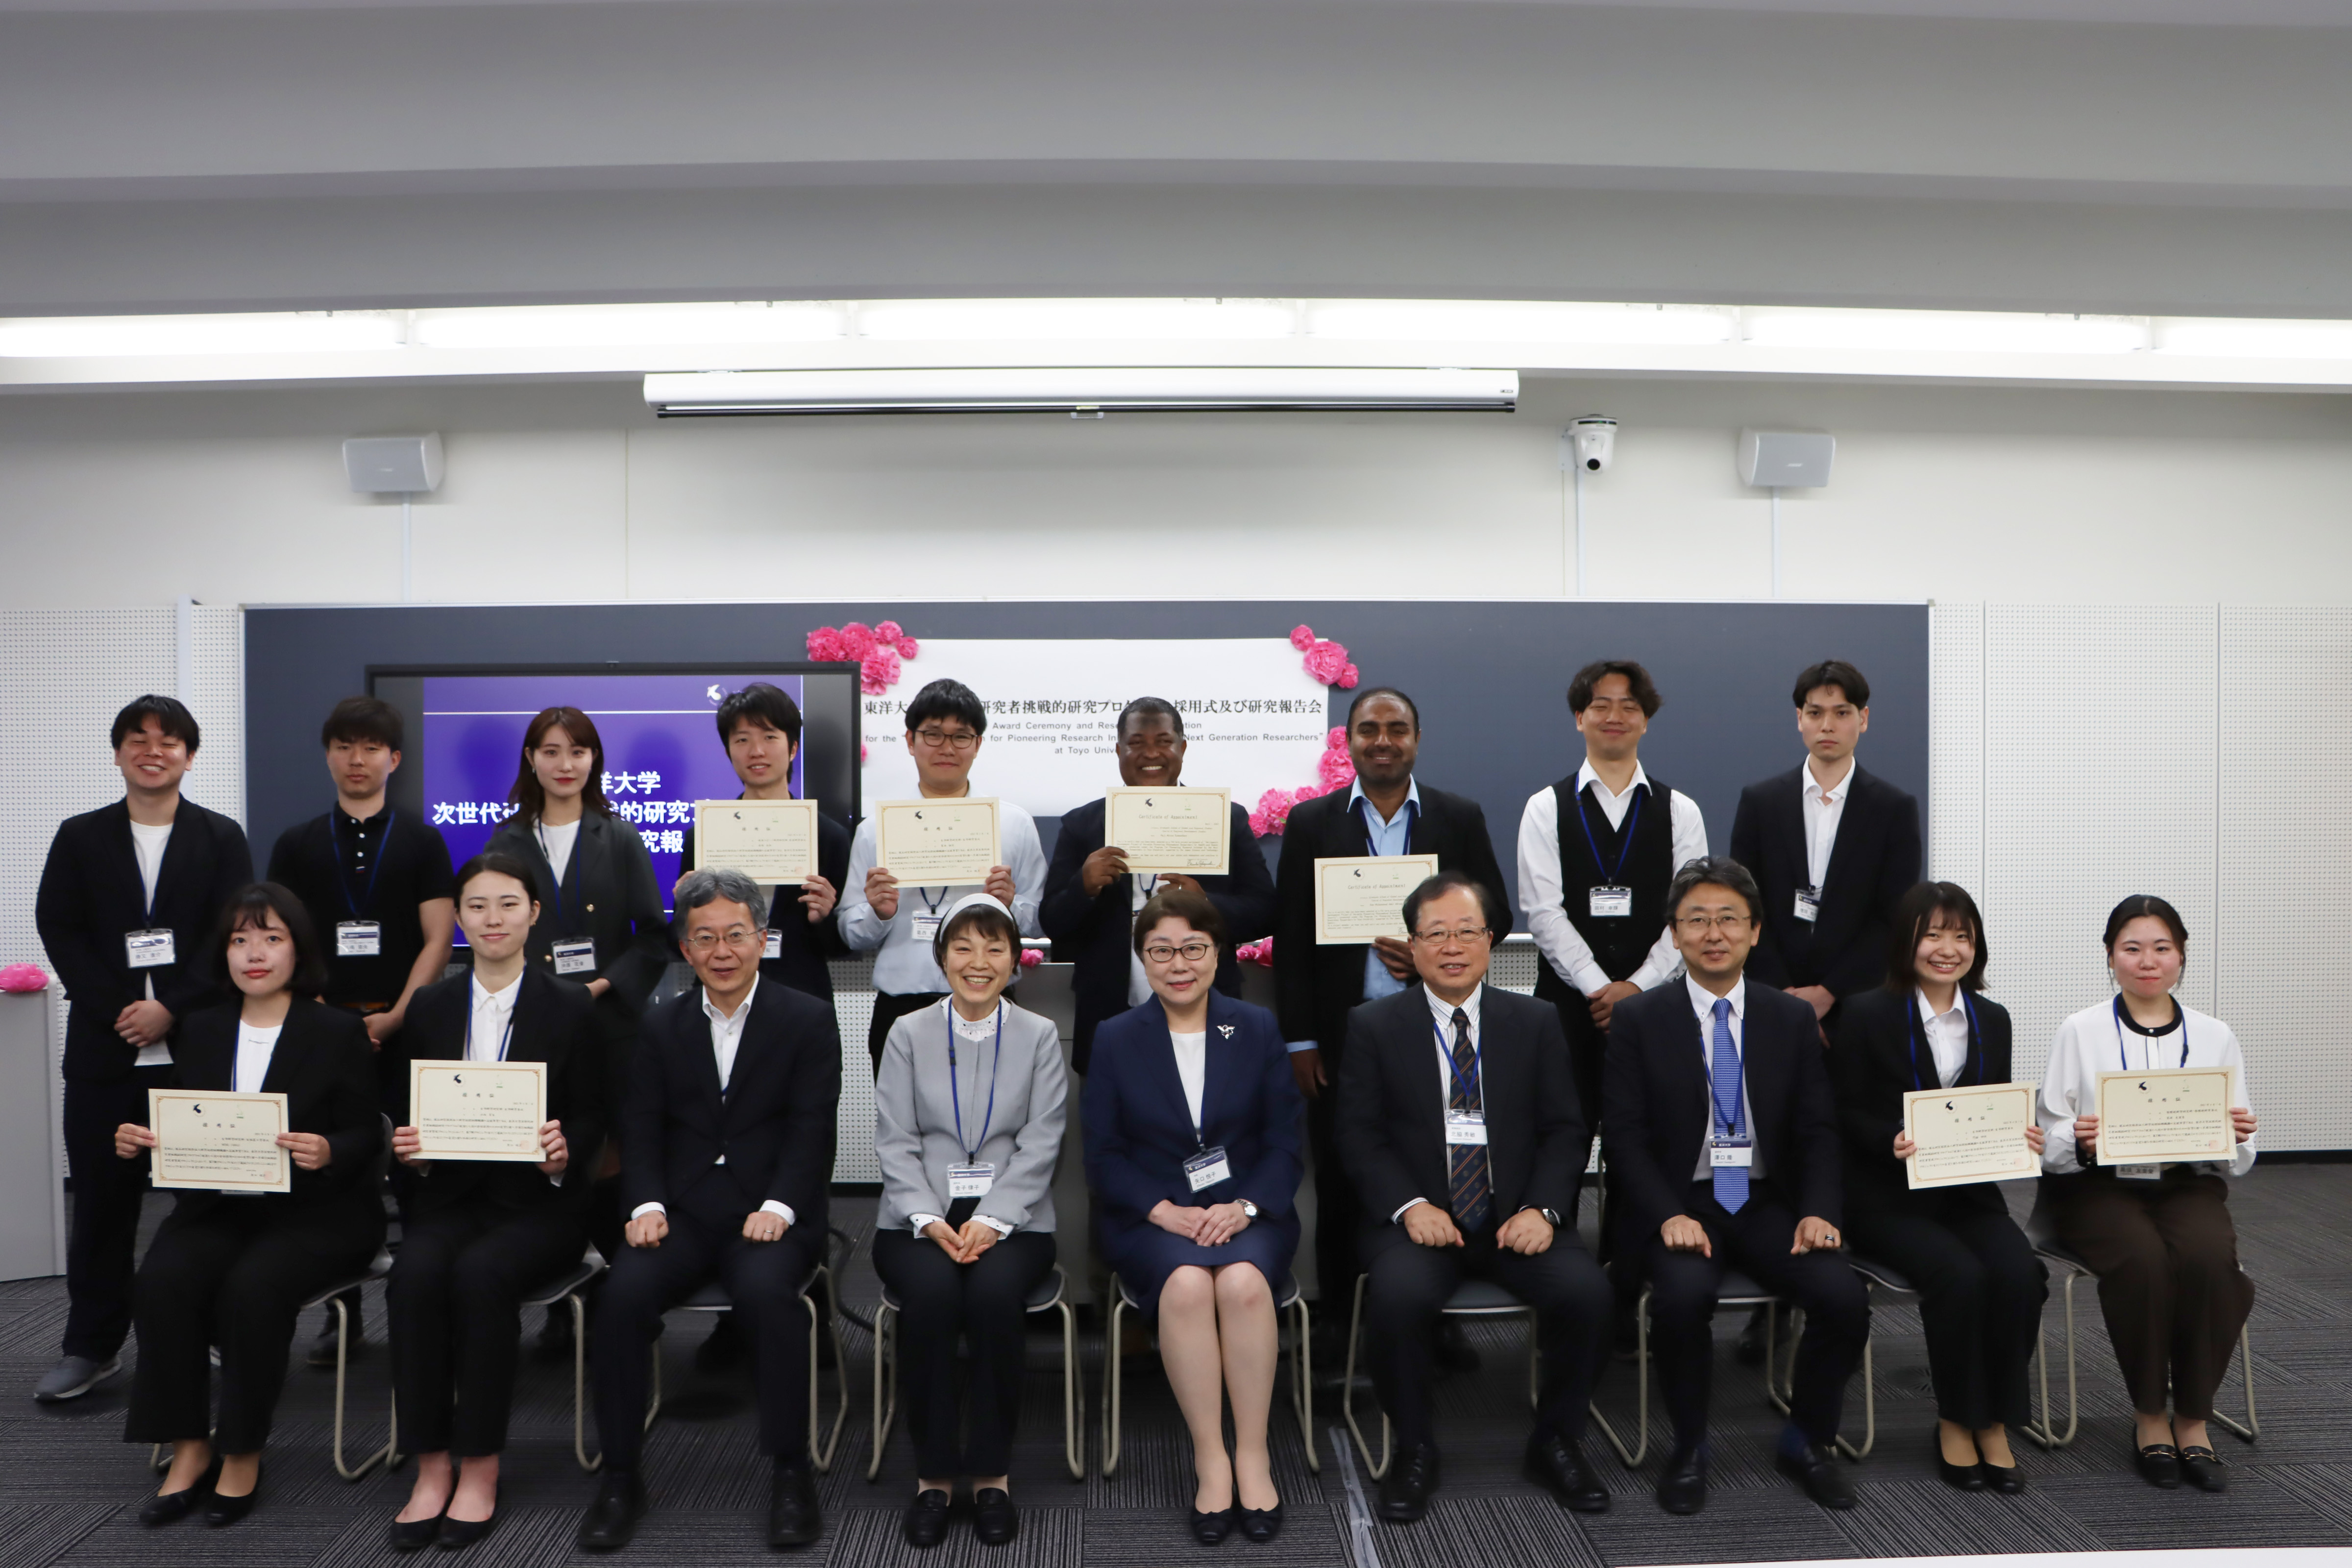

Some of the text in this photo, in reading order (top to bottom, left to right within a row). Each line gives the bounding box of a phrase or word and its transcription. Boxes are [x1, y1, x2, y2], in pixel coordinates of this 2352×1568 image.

[864, 700, 907, 714] 東洋大
[1026, 722, 1072, 731] Ceremony
[1007, 734, 1056, 743] Pioneering
[1208, 733, 1258, 741] Generation
[1068, 746, 1090, 756] Toyo
[601, 771, 662, 795] 洋大学
